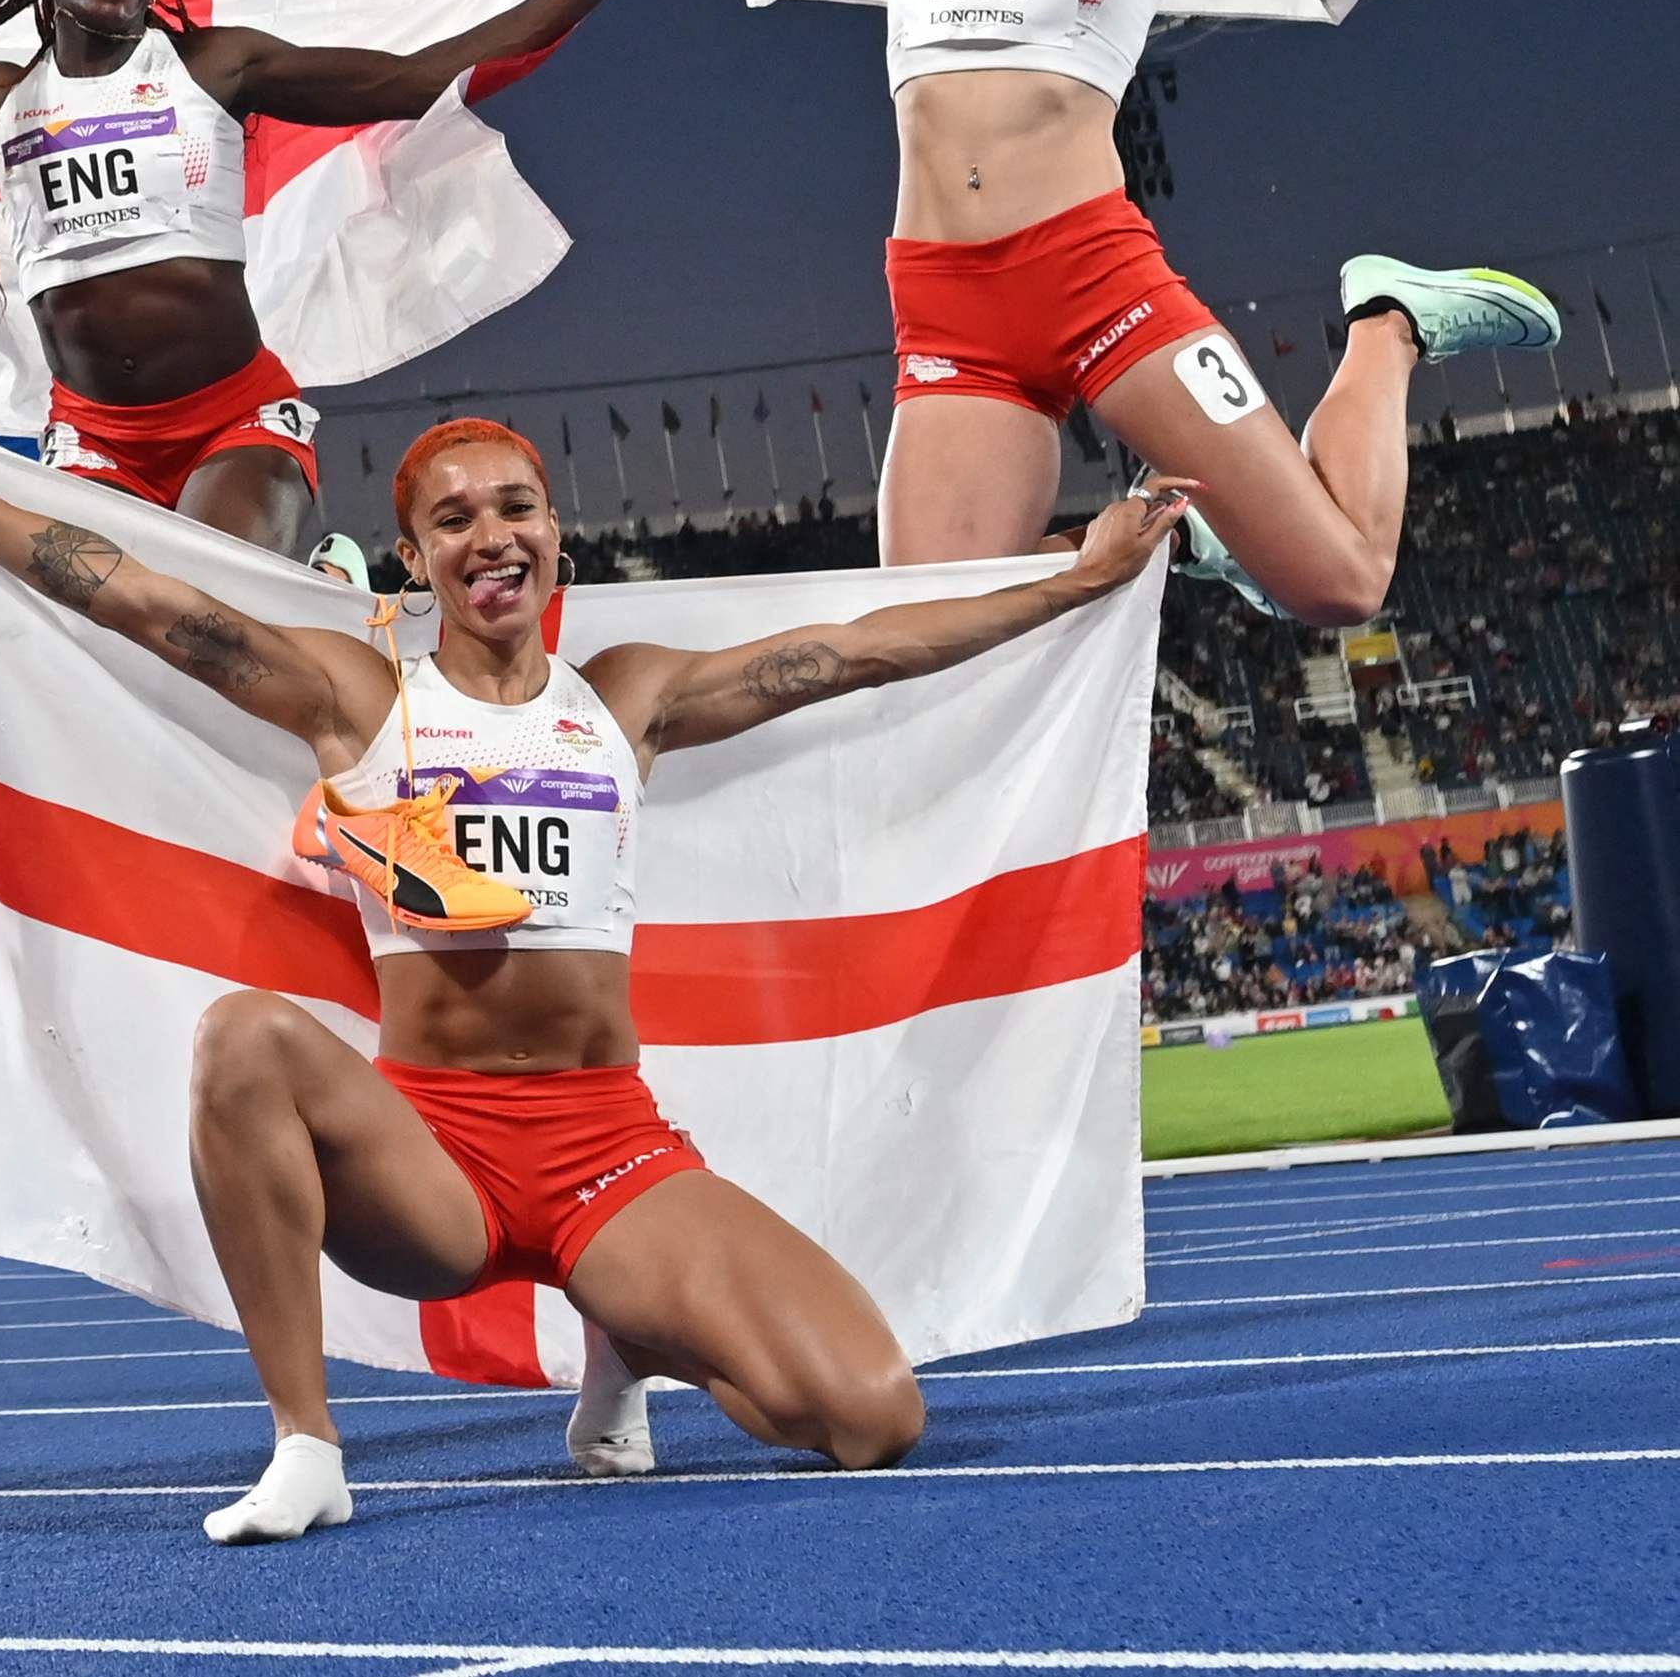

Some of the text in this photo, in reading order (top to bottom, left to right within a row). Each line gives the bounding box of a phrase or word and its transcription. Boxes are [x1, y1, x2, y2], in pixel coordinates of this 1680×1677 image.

[930, 9, 1024, 25] LONGINES
[123, 124, 153, 135] games
[39, 148, 139, 212] ENG
[52, 207, 141, 236] LONGINES
[1089, 300, 1154, 359] KUKRI
[1197, 346, 1248, 407] 3
[415, 727, 474, 739] KUKRI
[555, 737, 603, 748] ENGLAND
[541, 779, 614, 794] commonwealth
[561, 789, 593, 800] games
[455, 815, 570, 876] ENG
